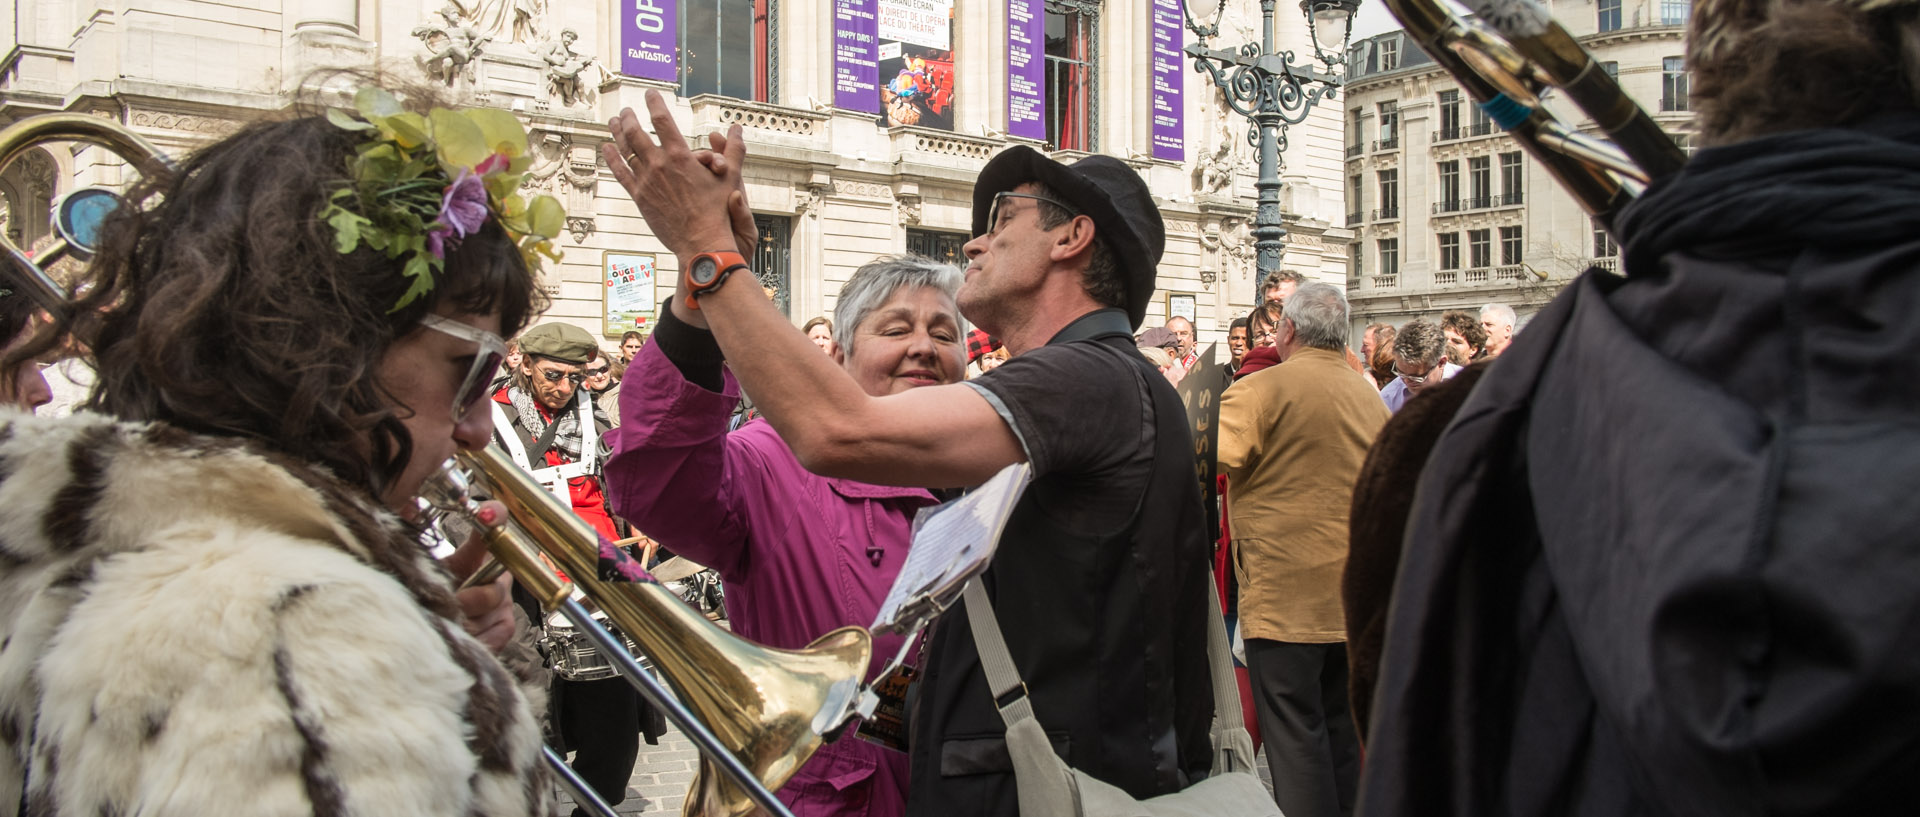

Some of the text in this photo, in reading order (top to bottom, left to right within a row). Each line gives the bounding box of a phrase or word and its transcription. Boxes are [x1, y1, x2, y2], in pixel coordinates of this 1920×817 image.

[885, 7, 908, 19] DIRECT
[910, 11, 918, 22] DE
[879, 16, 896, 28] LACE
[897, 20, 907, 30] DU
[838, 29, 856, 40] HAPPY
[856, 32, 870, 43] DAYS
[628, 48, 672, 63] FANTASTIC
